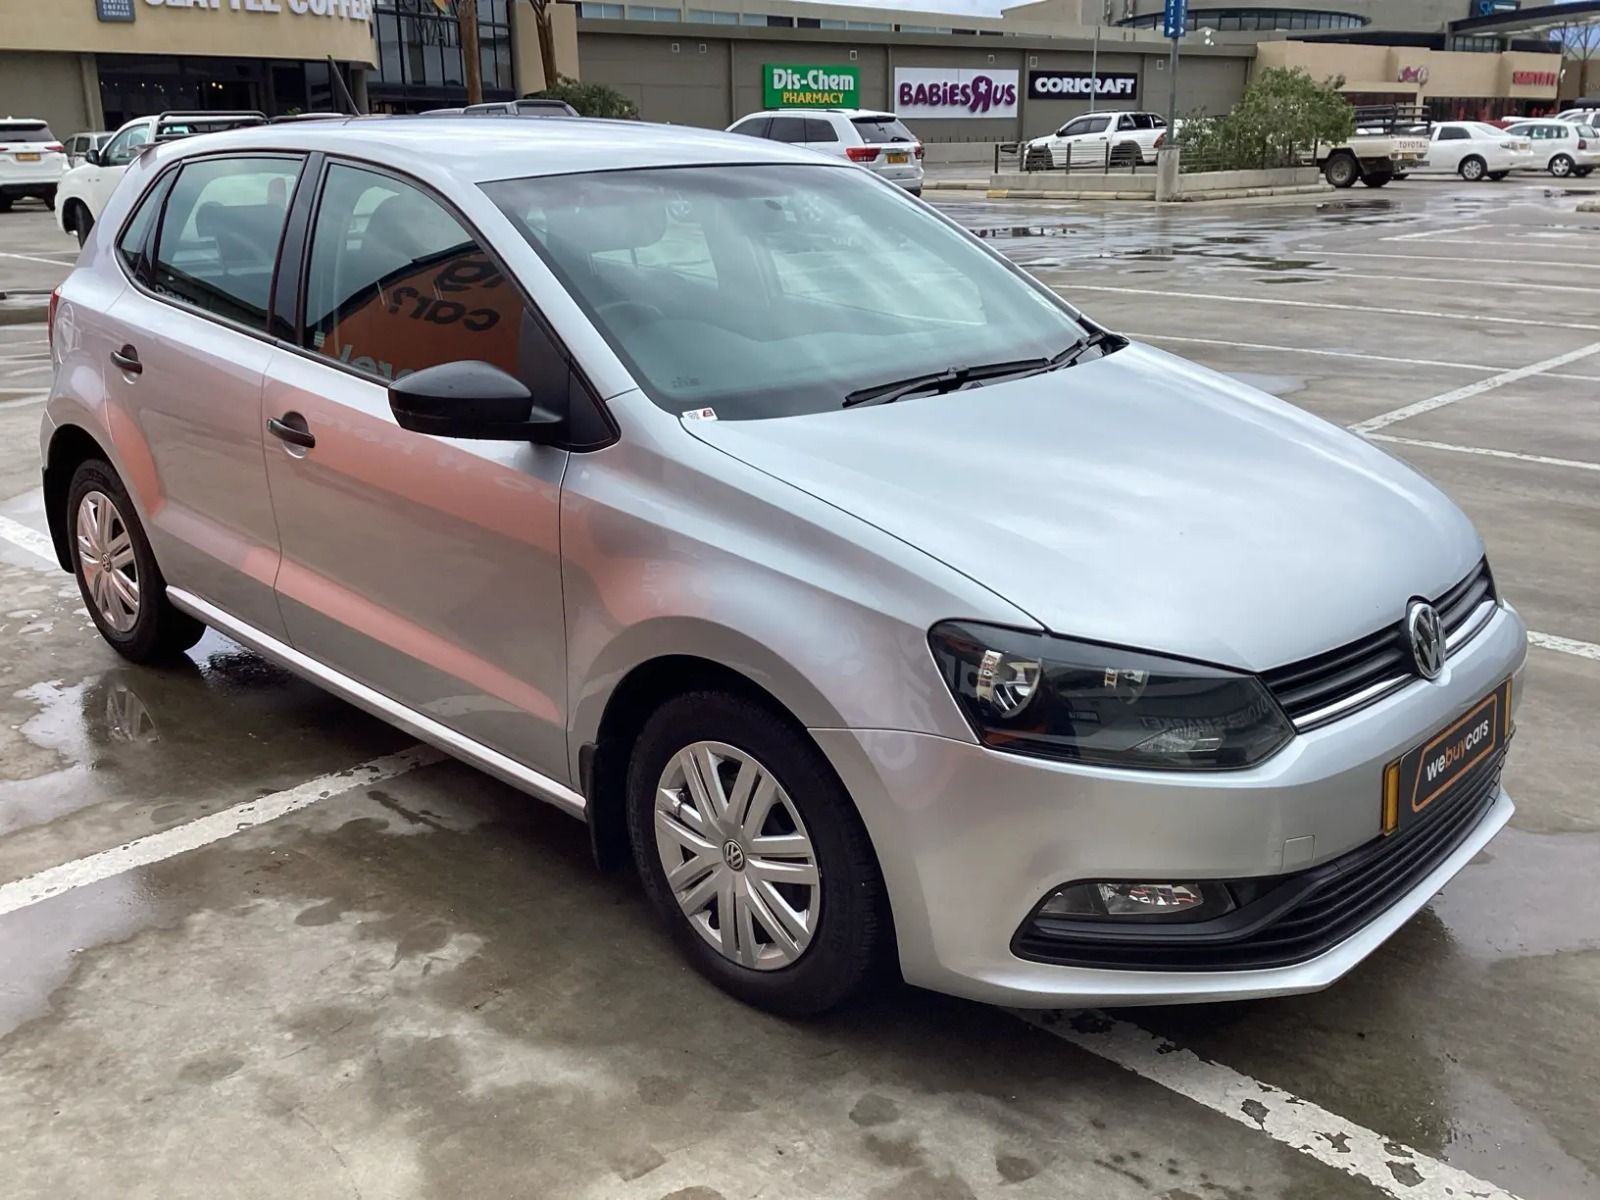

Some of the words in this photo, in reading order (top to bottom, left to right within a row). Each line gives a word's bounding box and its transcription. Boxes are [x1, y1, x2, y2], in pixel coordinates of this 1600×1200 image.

[773, 68, 855, 90] Dis-Chem
[1035, 77, 1135, 93] CORICRAFT
[783, 92, 844, 104] PHARMACY
[1427, 719, 1489, 782] webuycars
